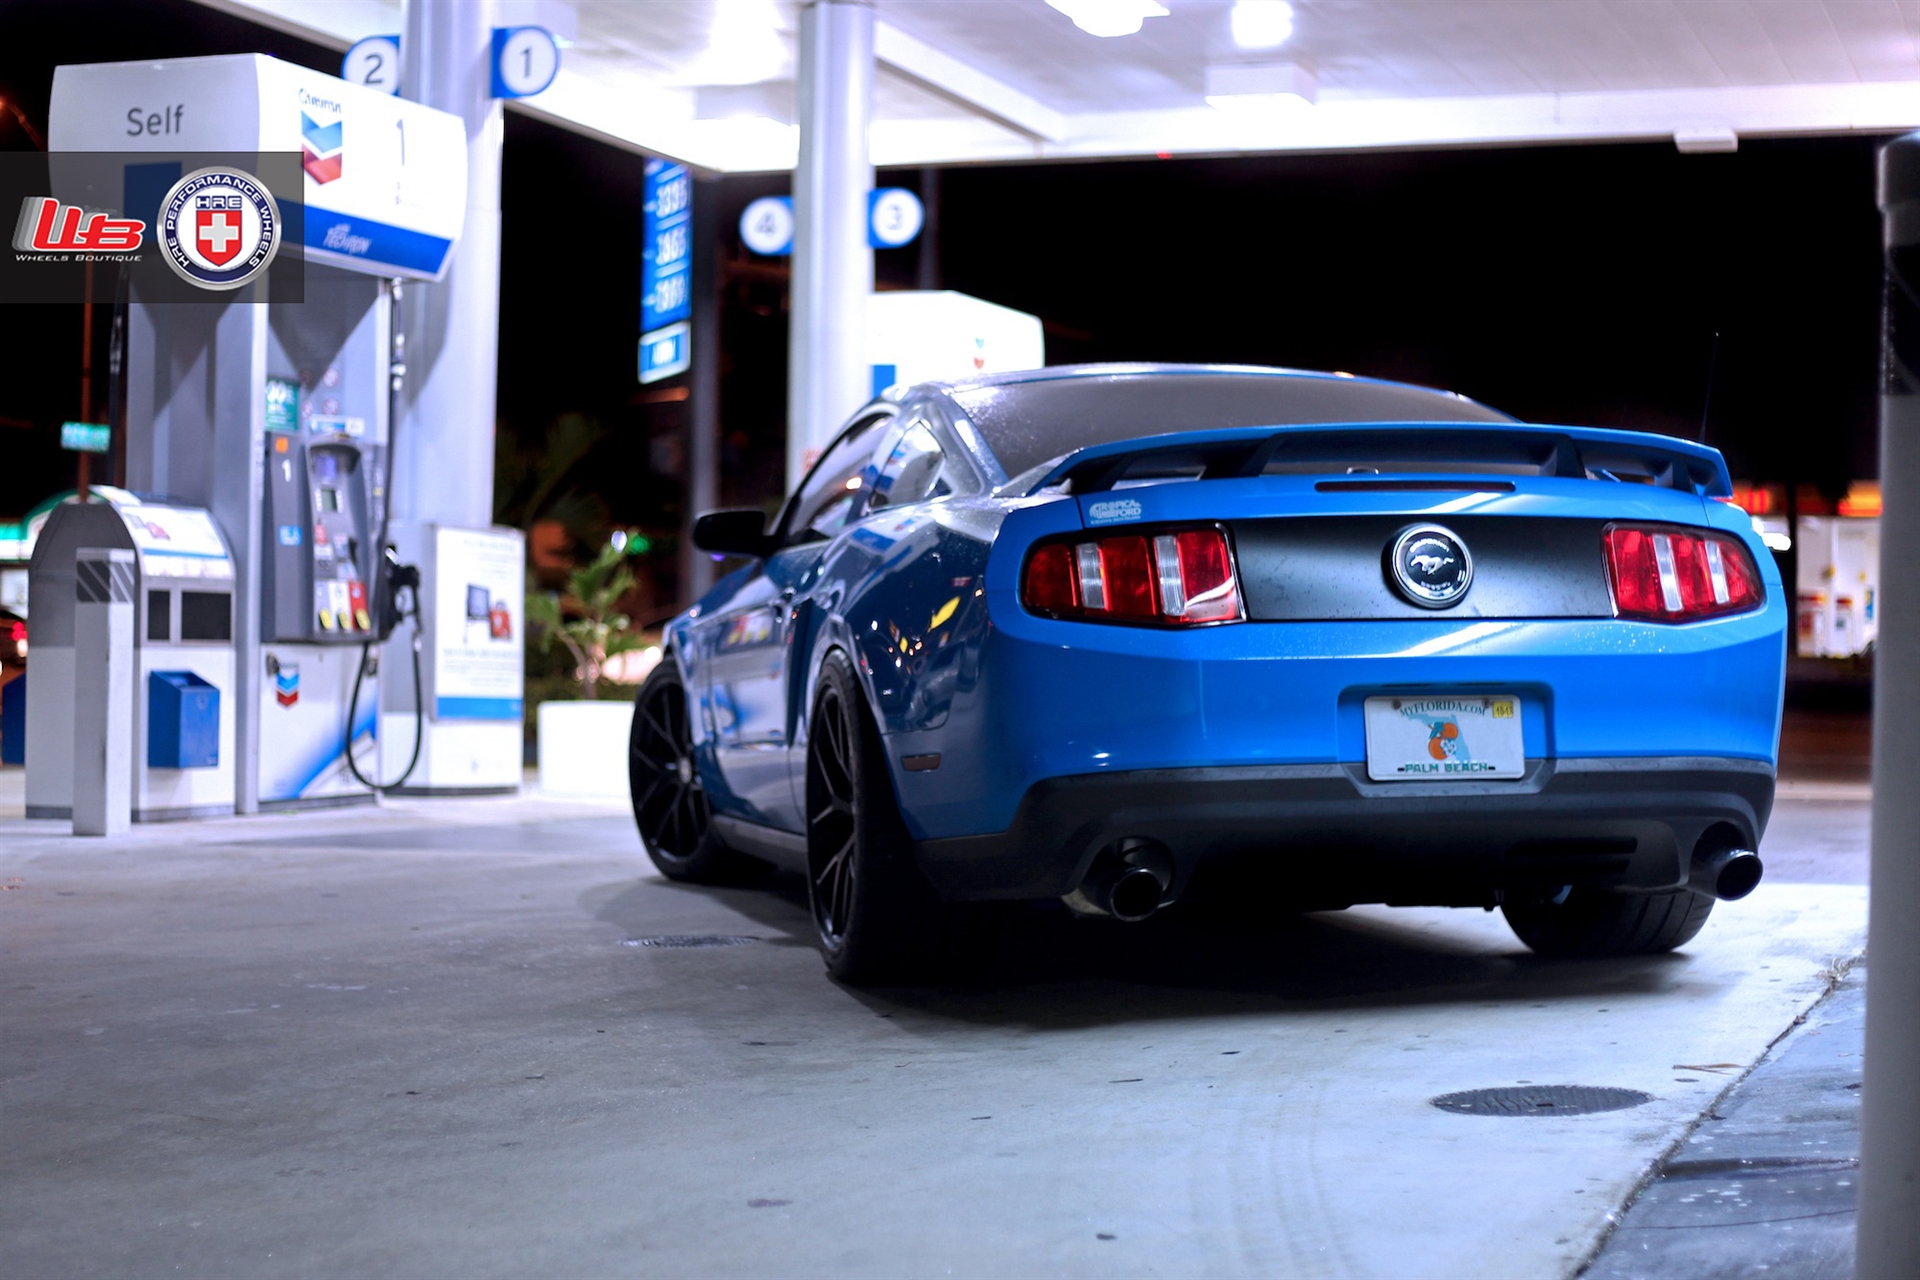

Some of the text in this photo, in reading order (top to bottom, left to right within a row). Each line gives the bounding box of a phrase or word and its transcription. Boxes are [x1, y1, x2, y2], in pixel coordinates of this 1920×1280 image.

[363, 52, 384, 85] 2
[519, 45, 532, 79] 1
[127, 103, 184, 137] Self
[396, 118, 405, 166] 1
[754, 210, 777, 237] 4
[884, 203, 904, 231] 3
[281, 458, 291, 483] 1
[1400, 701, 1486, 716] MYFLORIDA.COM
[1404, 762, 1488, 773] PALM BEACH
